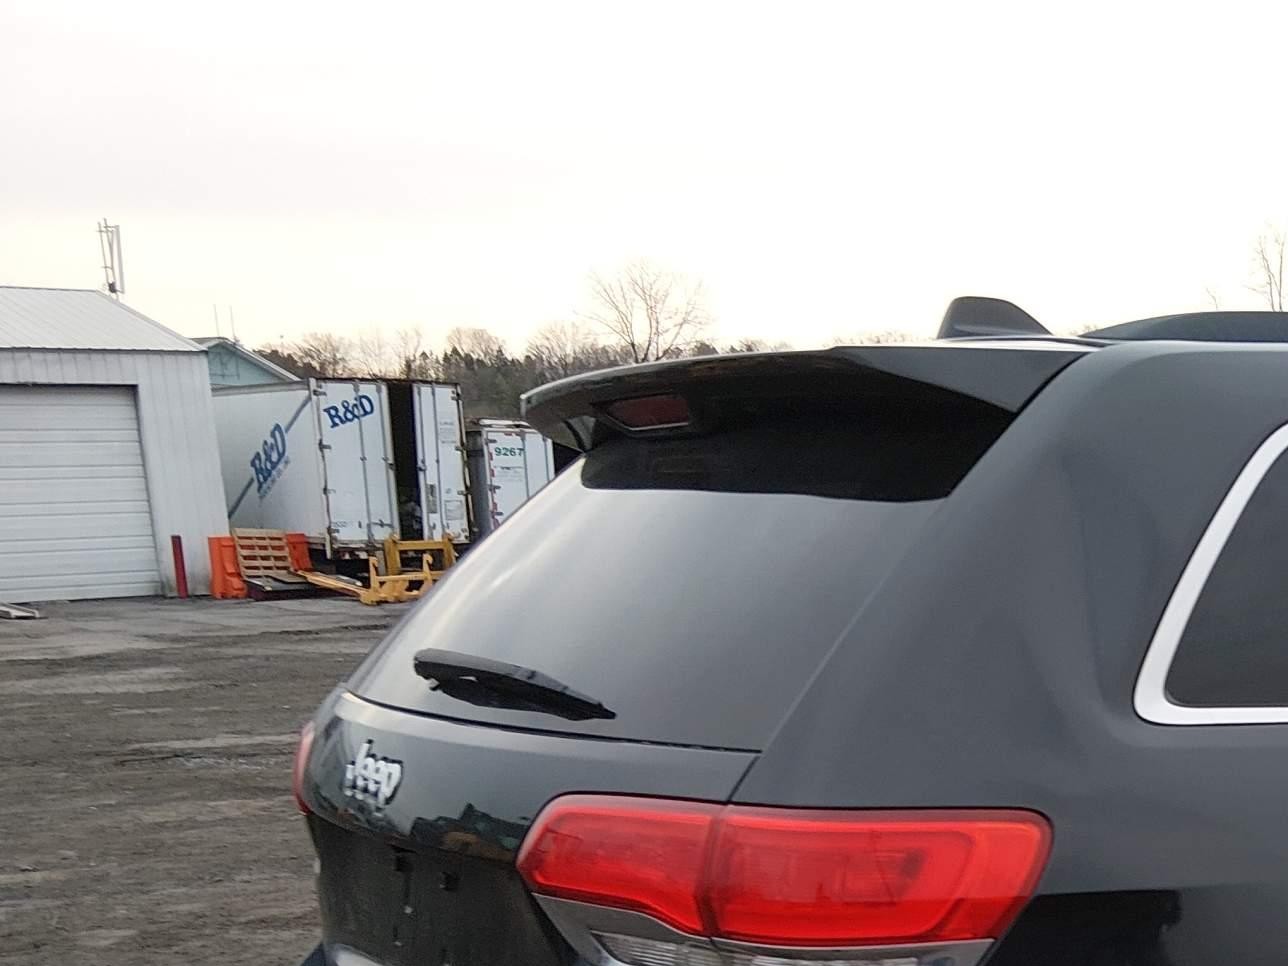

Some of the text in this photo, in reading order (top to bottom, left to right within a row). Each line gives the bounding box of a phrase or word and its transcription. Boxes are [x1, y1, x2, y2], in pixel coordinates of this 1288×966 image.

[323, 394, 375, 429] R&D
[250, 423, 287, 495] R&D
[494, 447, 525, 457] 9267
[344, 742, 402, 808] Jeep
